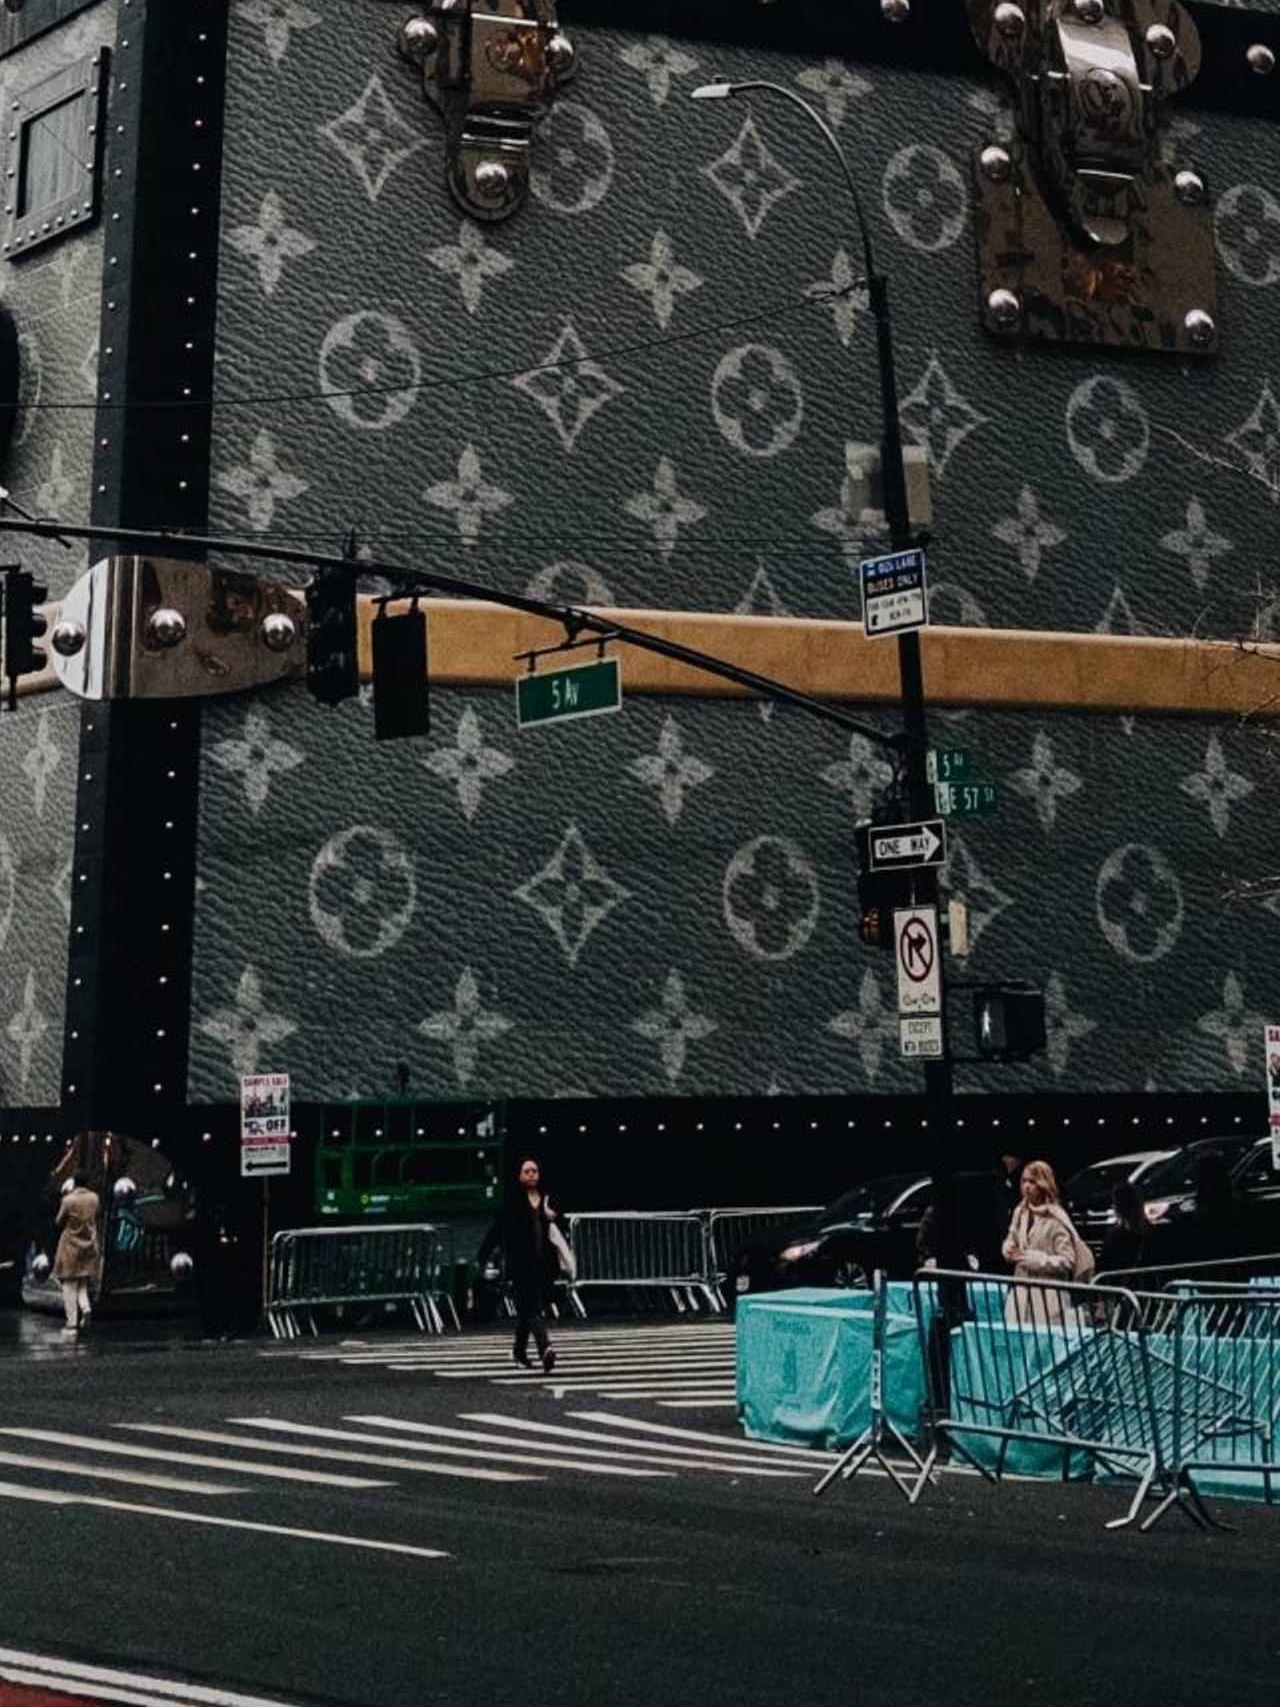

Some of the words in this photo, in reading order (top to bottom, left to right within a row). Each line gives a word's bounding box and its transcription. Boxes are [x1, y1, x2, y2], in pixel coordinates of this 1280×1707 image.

[551, 680, 560, 710] 5
[943, 753, 951, 777] 5
[963, 787, 979, 810] 57
[879, 840, 901, 856] ONE
[910, 837, 930, 852] WAY
